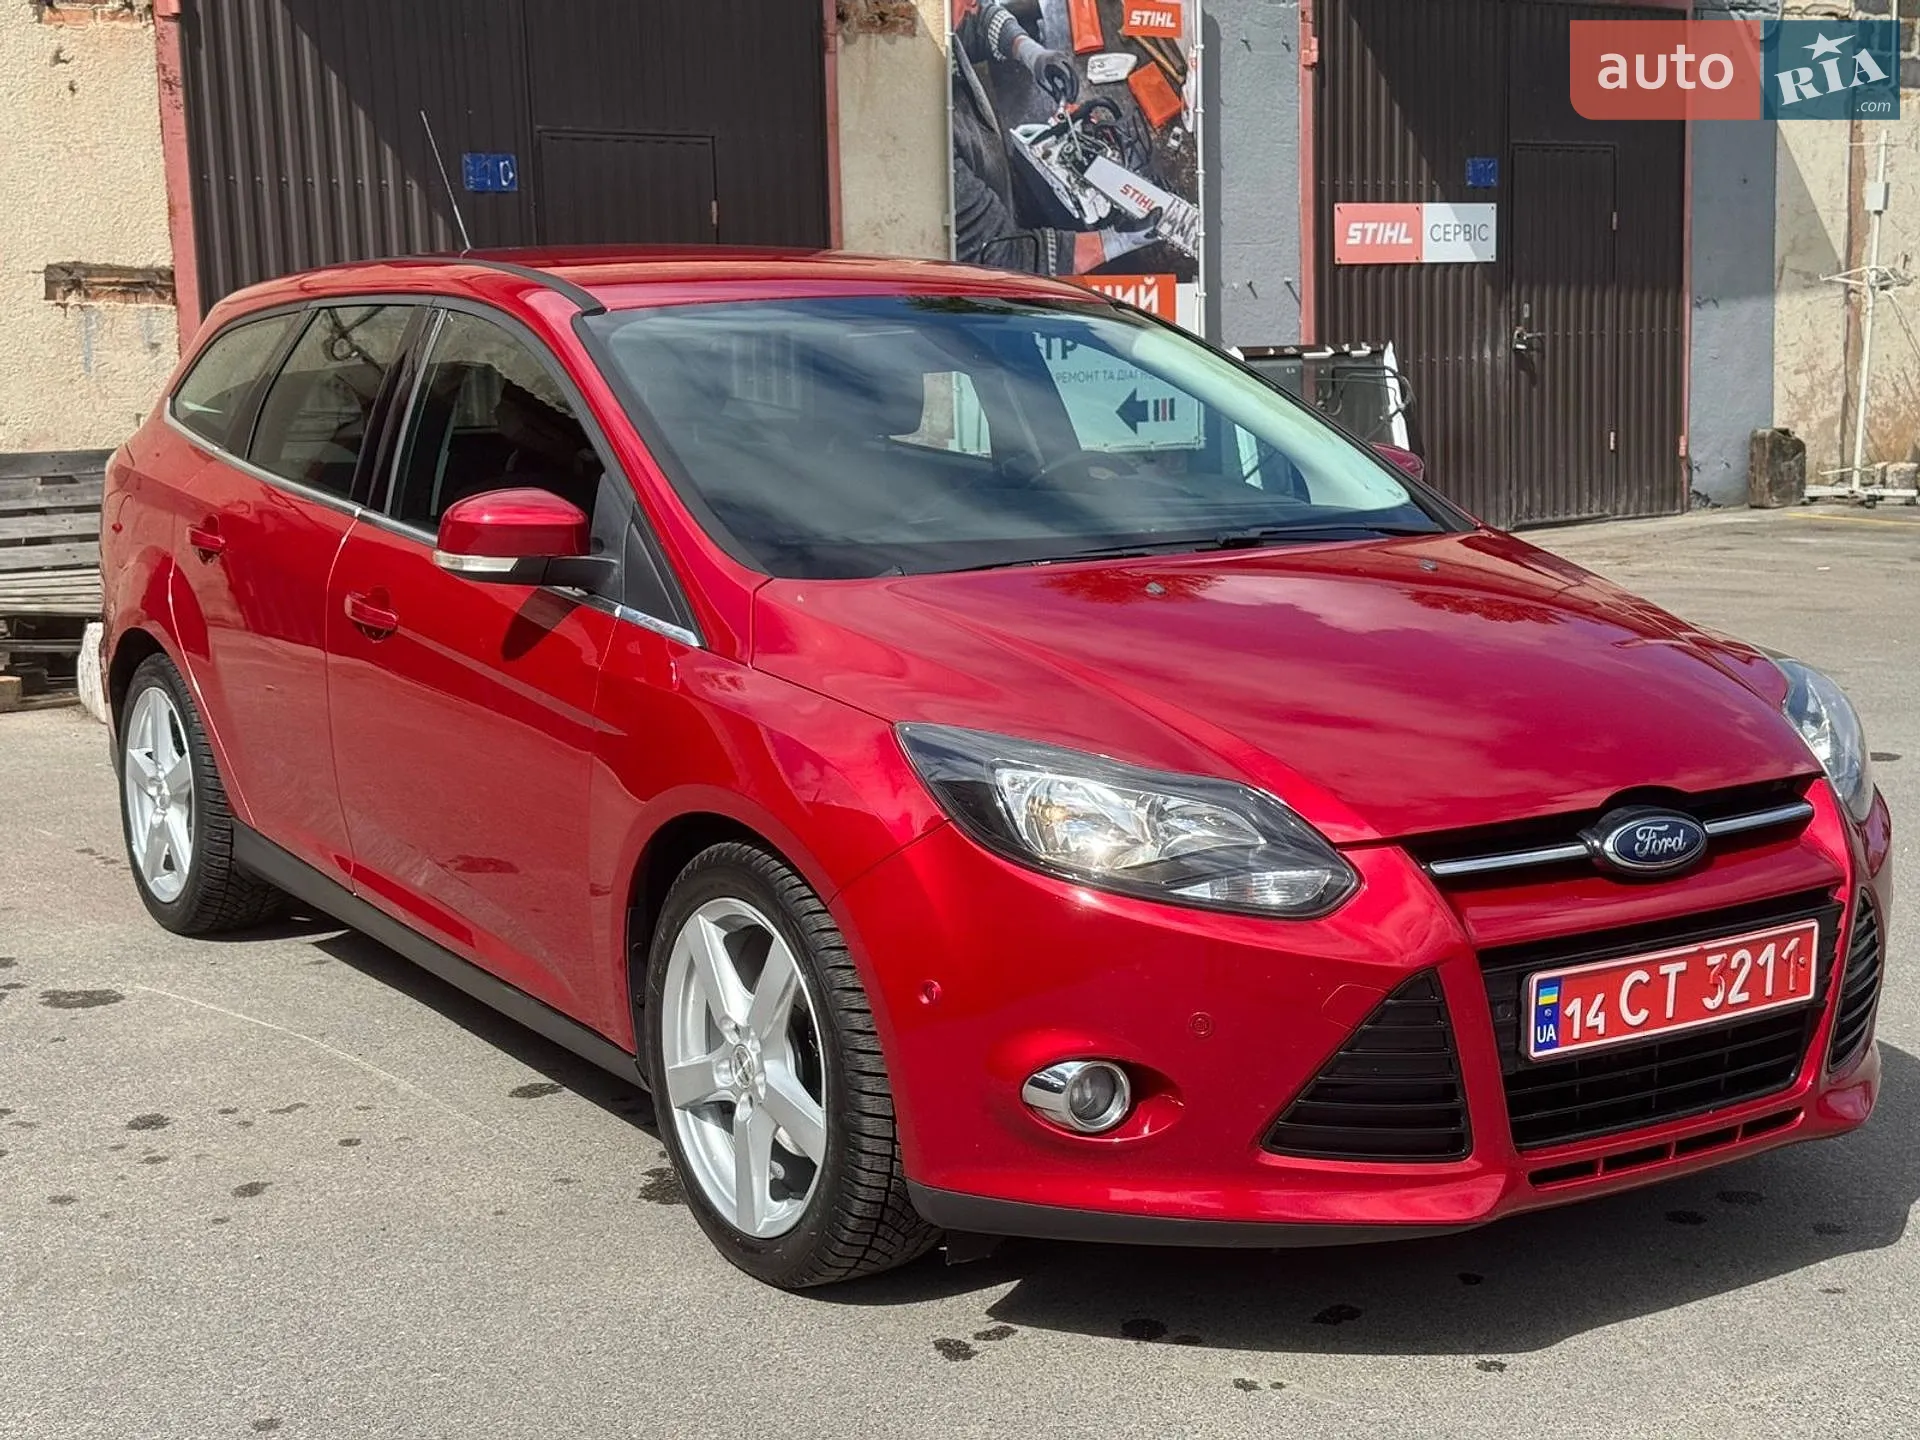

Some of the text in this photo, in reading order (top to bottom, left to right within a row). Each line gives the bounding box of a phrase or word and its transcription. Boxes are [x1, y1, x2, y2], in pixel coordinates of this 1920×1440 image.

[1129, 10, 1176, 28] STIHL
[1119, 183, 1155, 210] STIHL
[1346, 222, 1489, 245] STIHL СЕРВІС
[1634, 824, 1687, 857] Ford
[1563, 993, 1605, 1040] 14
[1618, 961, 1687, 1026] CT
[1537, 1024, 1557, 1043] UA
